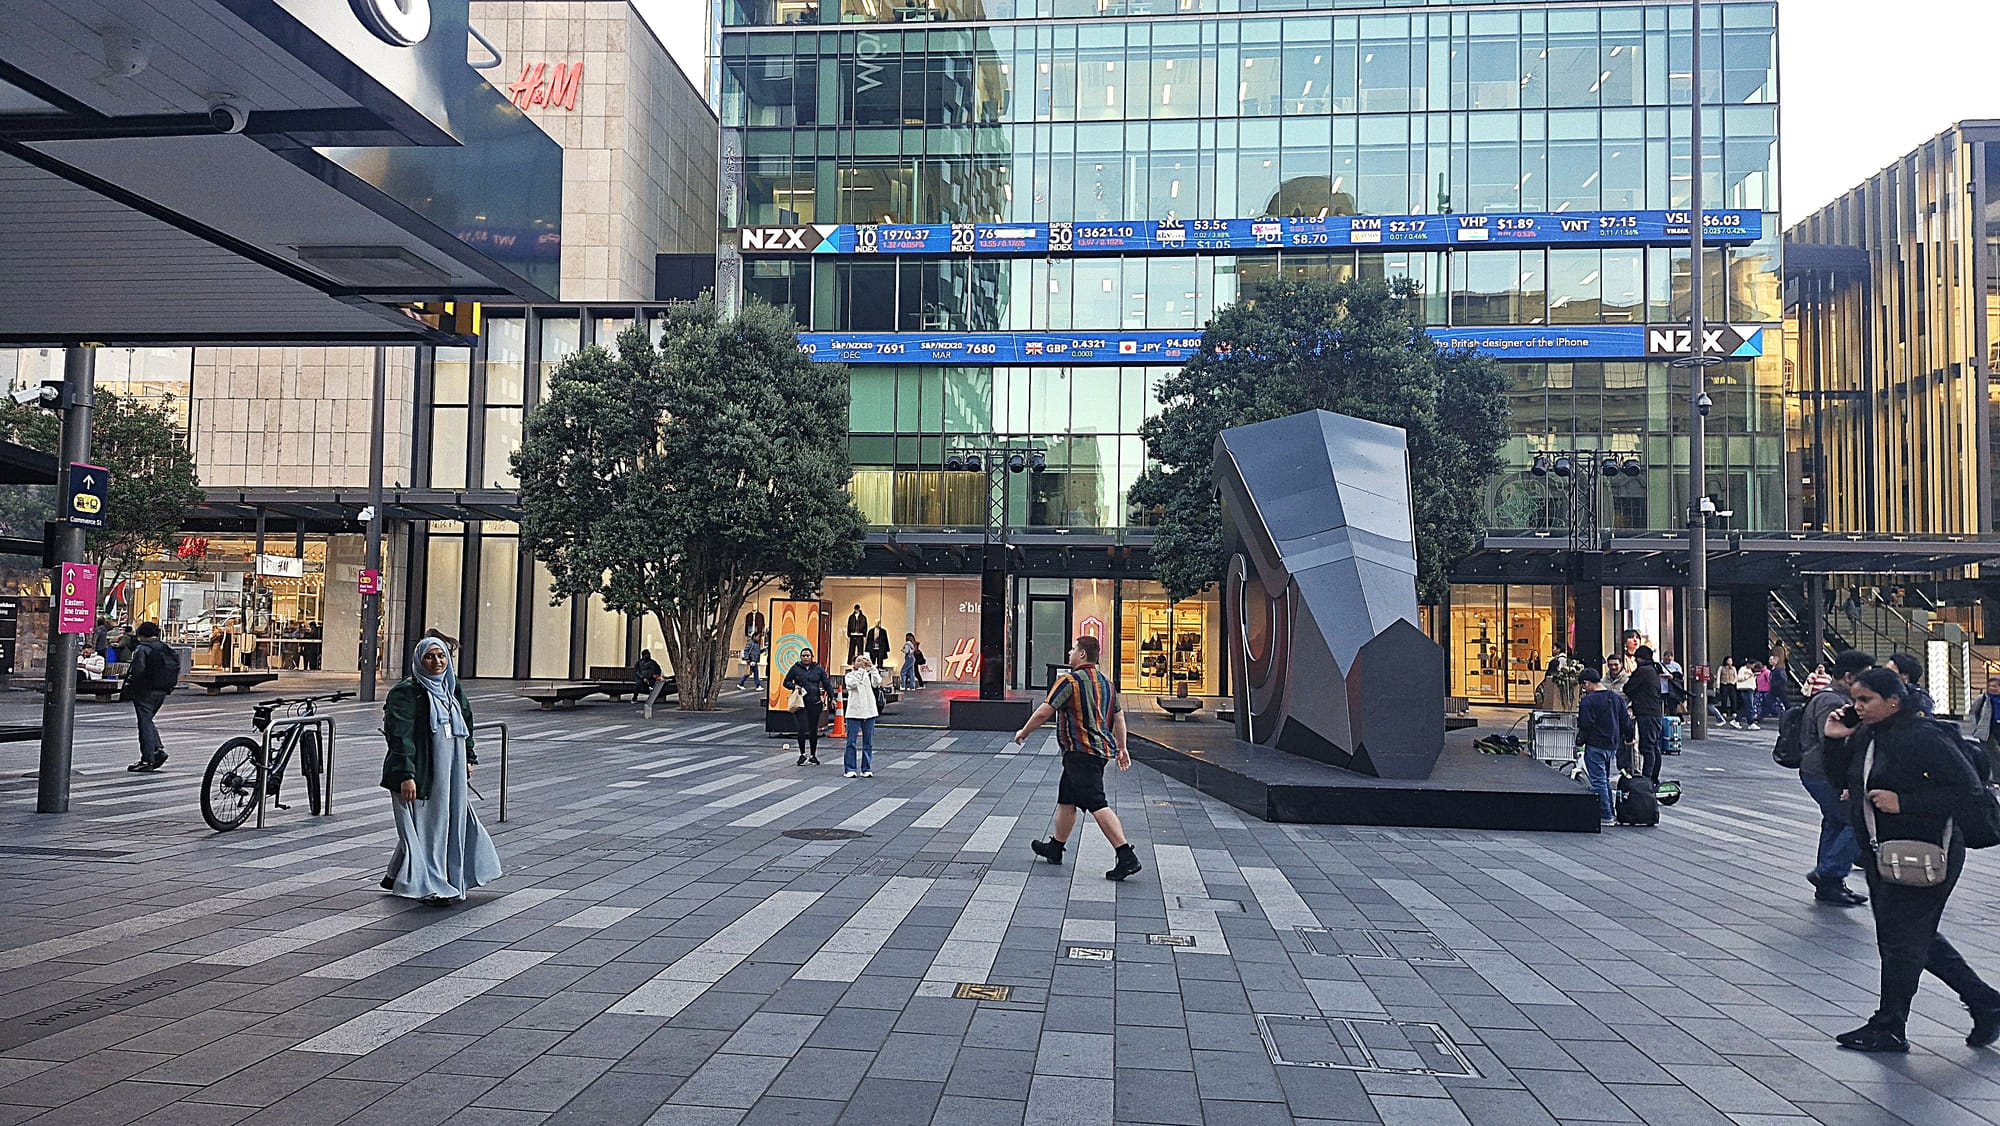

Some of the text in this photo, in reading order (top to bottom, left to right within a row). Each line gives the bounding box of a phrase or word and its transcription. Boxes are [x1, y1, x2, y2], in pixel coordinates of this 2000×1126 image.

[508, 62, 583, 111] H&M
[1459, 216, 1488, 227] VHP
[1599, 216, 1637, 228] $7.15
[1665, 212, 1692, 224] VSL
[1703, 214, 1740, 227] $6.03
[1351, 218, 1381, 230] RYM
[1389, 220, 1426, 232] $2.17
[1497, 218, 1534, 230] $1.89
[1560, 220, 1591, 232] VNT
[857, 230, 877, 246] 10
[883, 230, 930, 240] 1970.37
[952, 229, 975, 245] 20
[1048, 228, 1073, 244] 50
[1077, 227, 1133, 238] 13621.10
[741, 228, 807, 250] NZX
[1292, 233, 1328, 245] $8.70
[855, 245, 878, 253] INDEX
[951, 244, 975, 252] INDEX
[1048, 243, 1073, 251] INDEX
[1072, 339, 1106, 348] 0.4321
[1451, 338, 1480, 348] British
[1482, 338, 1523, 349] designer
[1525, 338, 1537, 348] of
[1537, 338, 1553, 348] the
[1650, 329, 1725, 353] NZX
[876, 343, 905, 354] 7691
[966, 343, 996, 354] 7680
[1046, 344, 1068, 353] GBP
[1141, 343, 1161, 352] JPY
[843, 351, 861, 359] DEC
[932, 351, 951, 359] MAR
[70, 515, 96, 525] Commerce
[64, 598, 85, 607] Eastern
[64, 607, 89, 616] line trains
[944, 637, 981, 680] H&
[96, 978, 177, 1004] Galway
